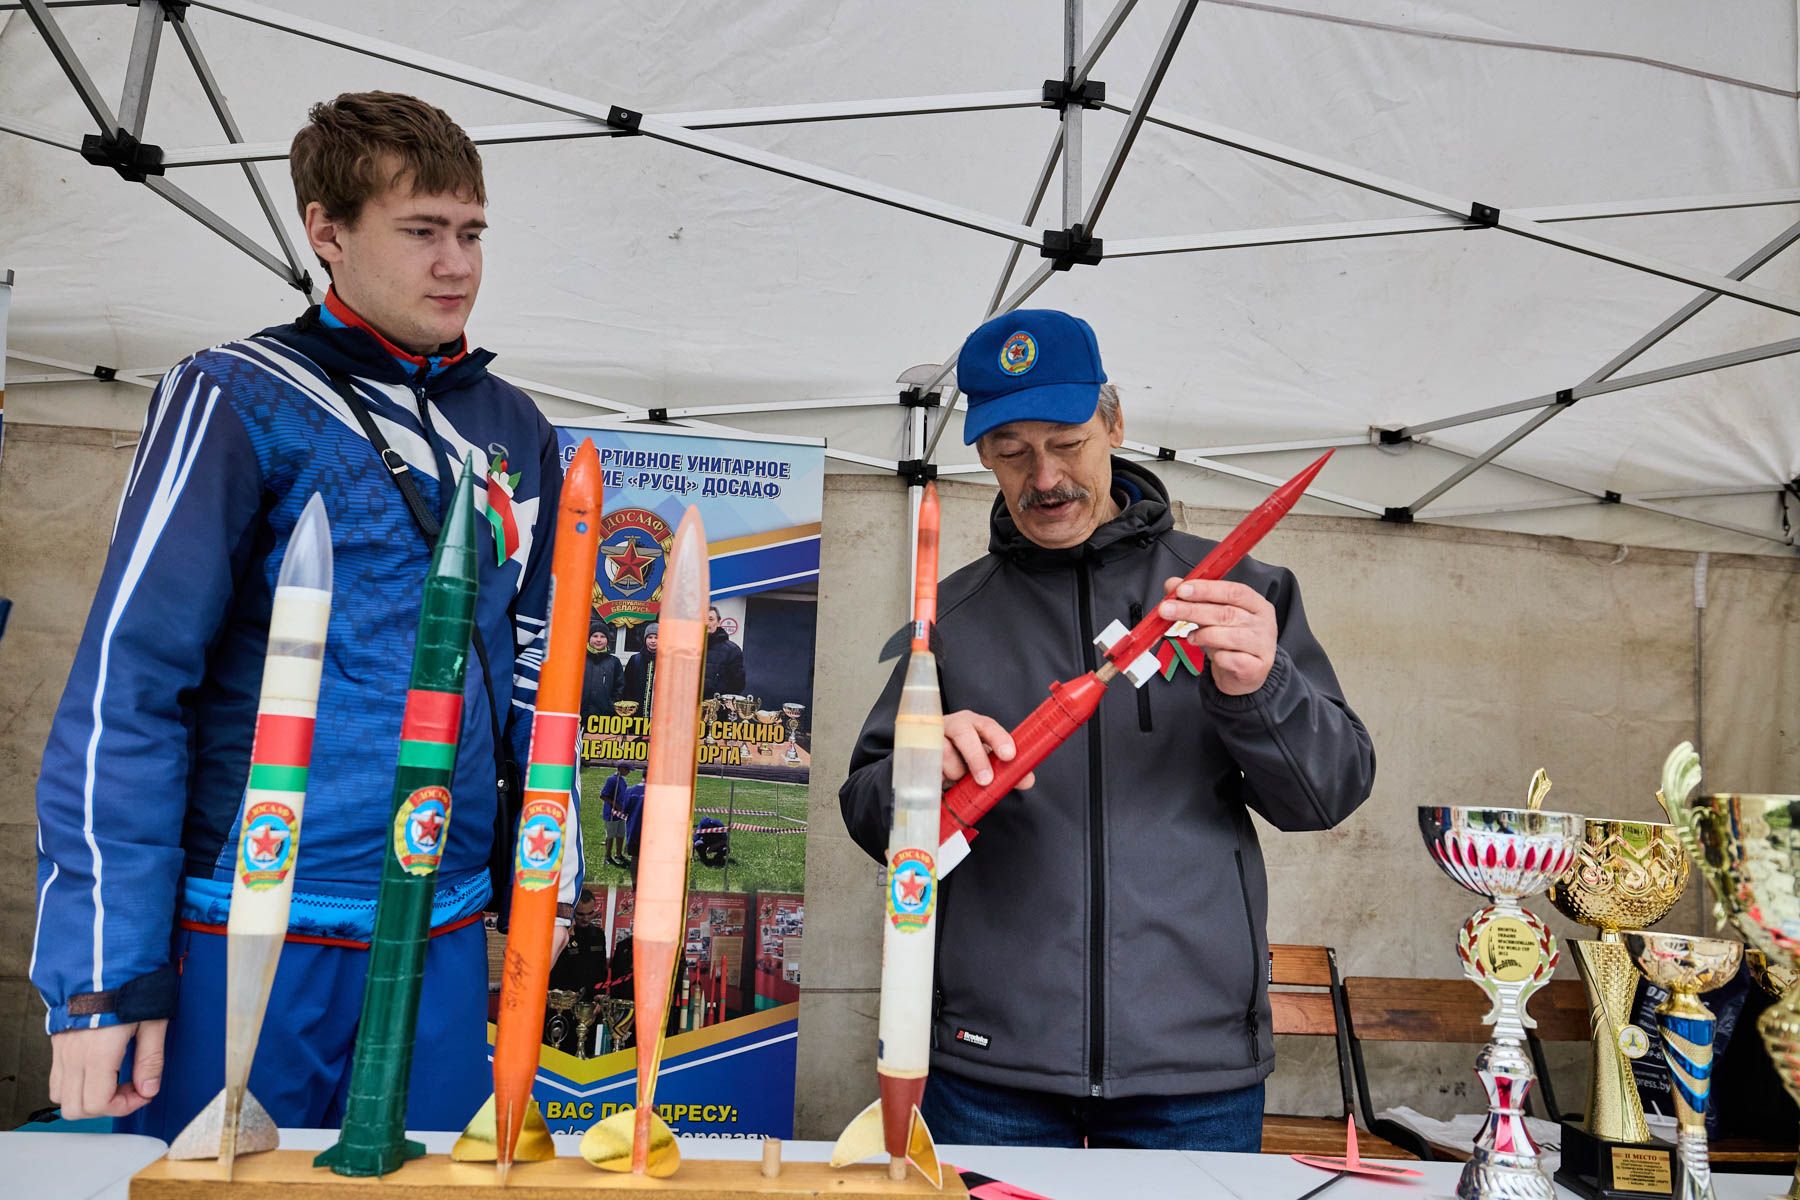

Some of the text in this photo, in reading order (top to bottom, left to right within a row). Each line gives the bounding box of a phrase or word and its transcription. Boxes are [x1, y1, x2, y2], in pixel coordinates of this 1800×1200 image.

[687, 455, 791, 479] УНИТАРНОЕ
[627, 472, 698, 495] «РУСЦ»
[701, 477, 782, 498] ДОСААФ
[607, 511, 664, 531] ДОСААФ
[711, 720, 785, 744] СЕКЦИЮ
[697, 744, 741, 765] ОРТА
[546, 1101, 595, 1120] ВАС
[656, 1103, 738, 1124] ДРЕСУ:
[1633, 1153, 1657, 1161] МЕСТО
